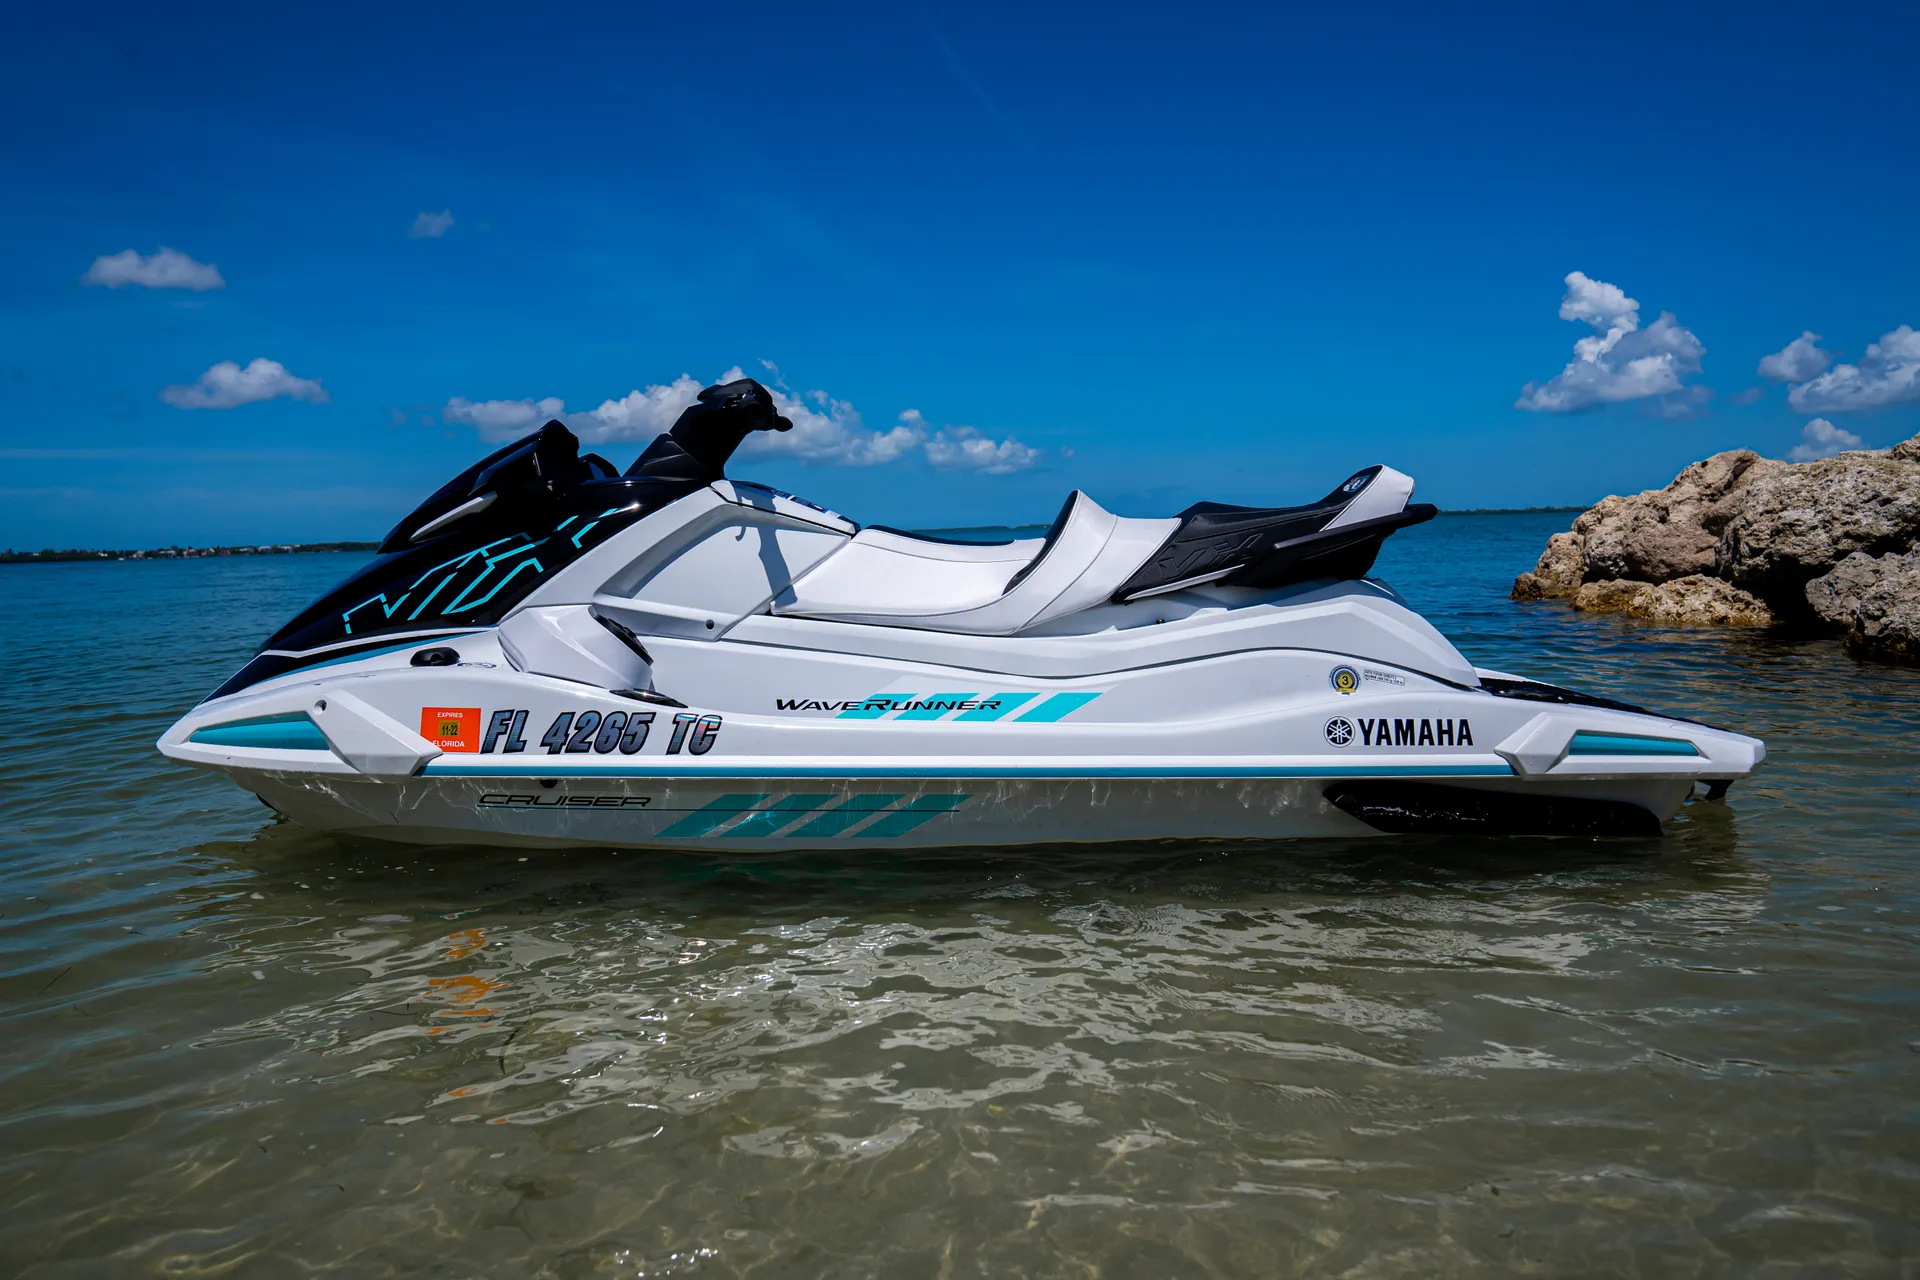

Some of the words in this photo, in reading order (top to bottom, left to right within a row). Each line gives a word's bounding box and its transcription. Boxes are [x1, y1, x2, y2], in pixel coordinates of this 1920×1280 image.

[1342, 675, 1349, 686] 3
[442, 724, 458, 736] 11-22
[479, 708, 530, 754] FL
[539, 710, 657, 755] 4265
[665, 712, 723, 755] TC
[1357, 718, 1473, 746] YAMAHA
[478, 793, 652, 807] CRUISER
